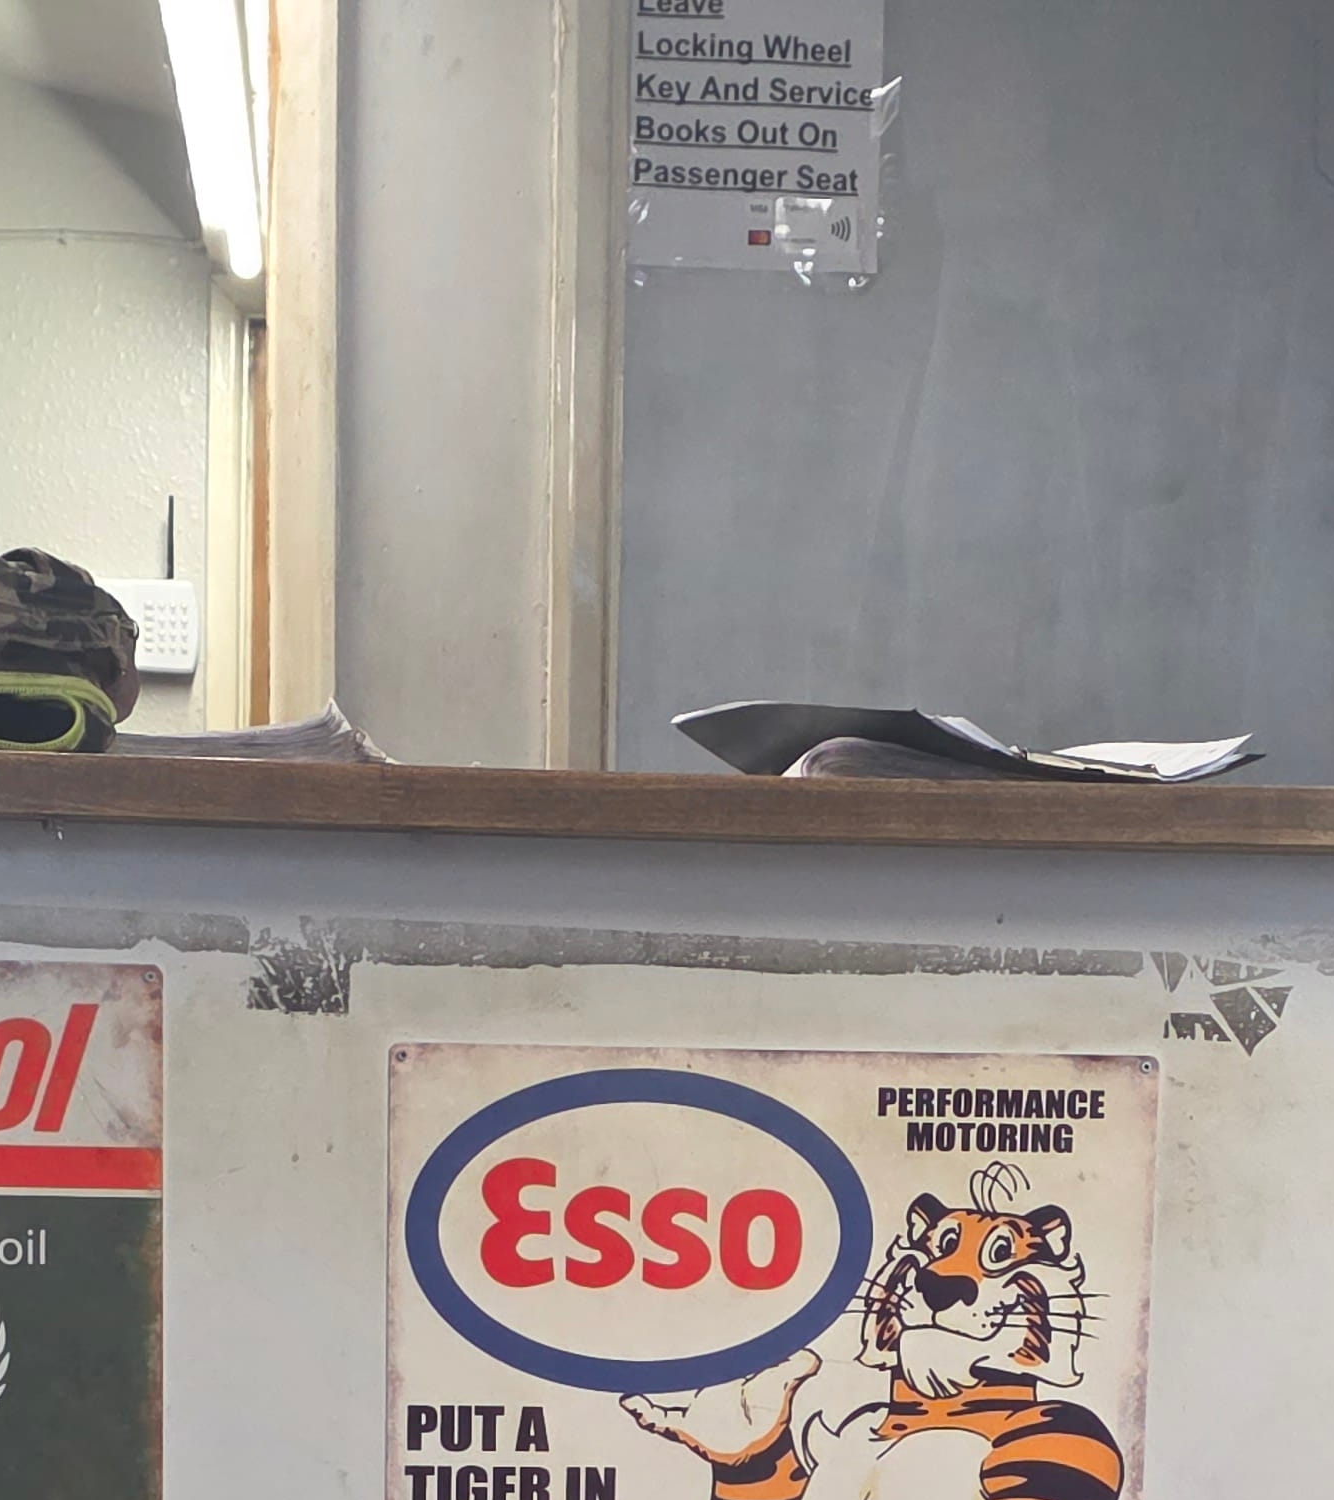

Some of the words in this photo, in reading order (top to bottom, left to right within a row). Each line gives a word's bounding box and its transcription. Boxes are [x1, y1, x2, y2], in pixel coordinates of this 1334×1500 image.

[637, 31, 754, 64] Locking
[763, 34, 852, 63] Wheel
[636, 73, 691, 105] Key
[701, 76, 759, 102] And
[769, 78, 875, 107] Service
[635, 115, 727, 143] Books
[737, 120, 789, 146] Out
[798, 122, 838, 148] On
[634, 158, 788, 192] Passenger
[797, 164, 858, 192] Seat
[877, 1086, 1106, 1121] PERFORMANCE
[905, 1122, 1074, 1154] MOTORING
[406, 1405, 506, 1453] PUT
[516, 1406, 550, 1453] A
